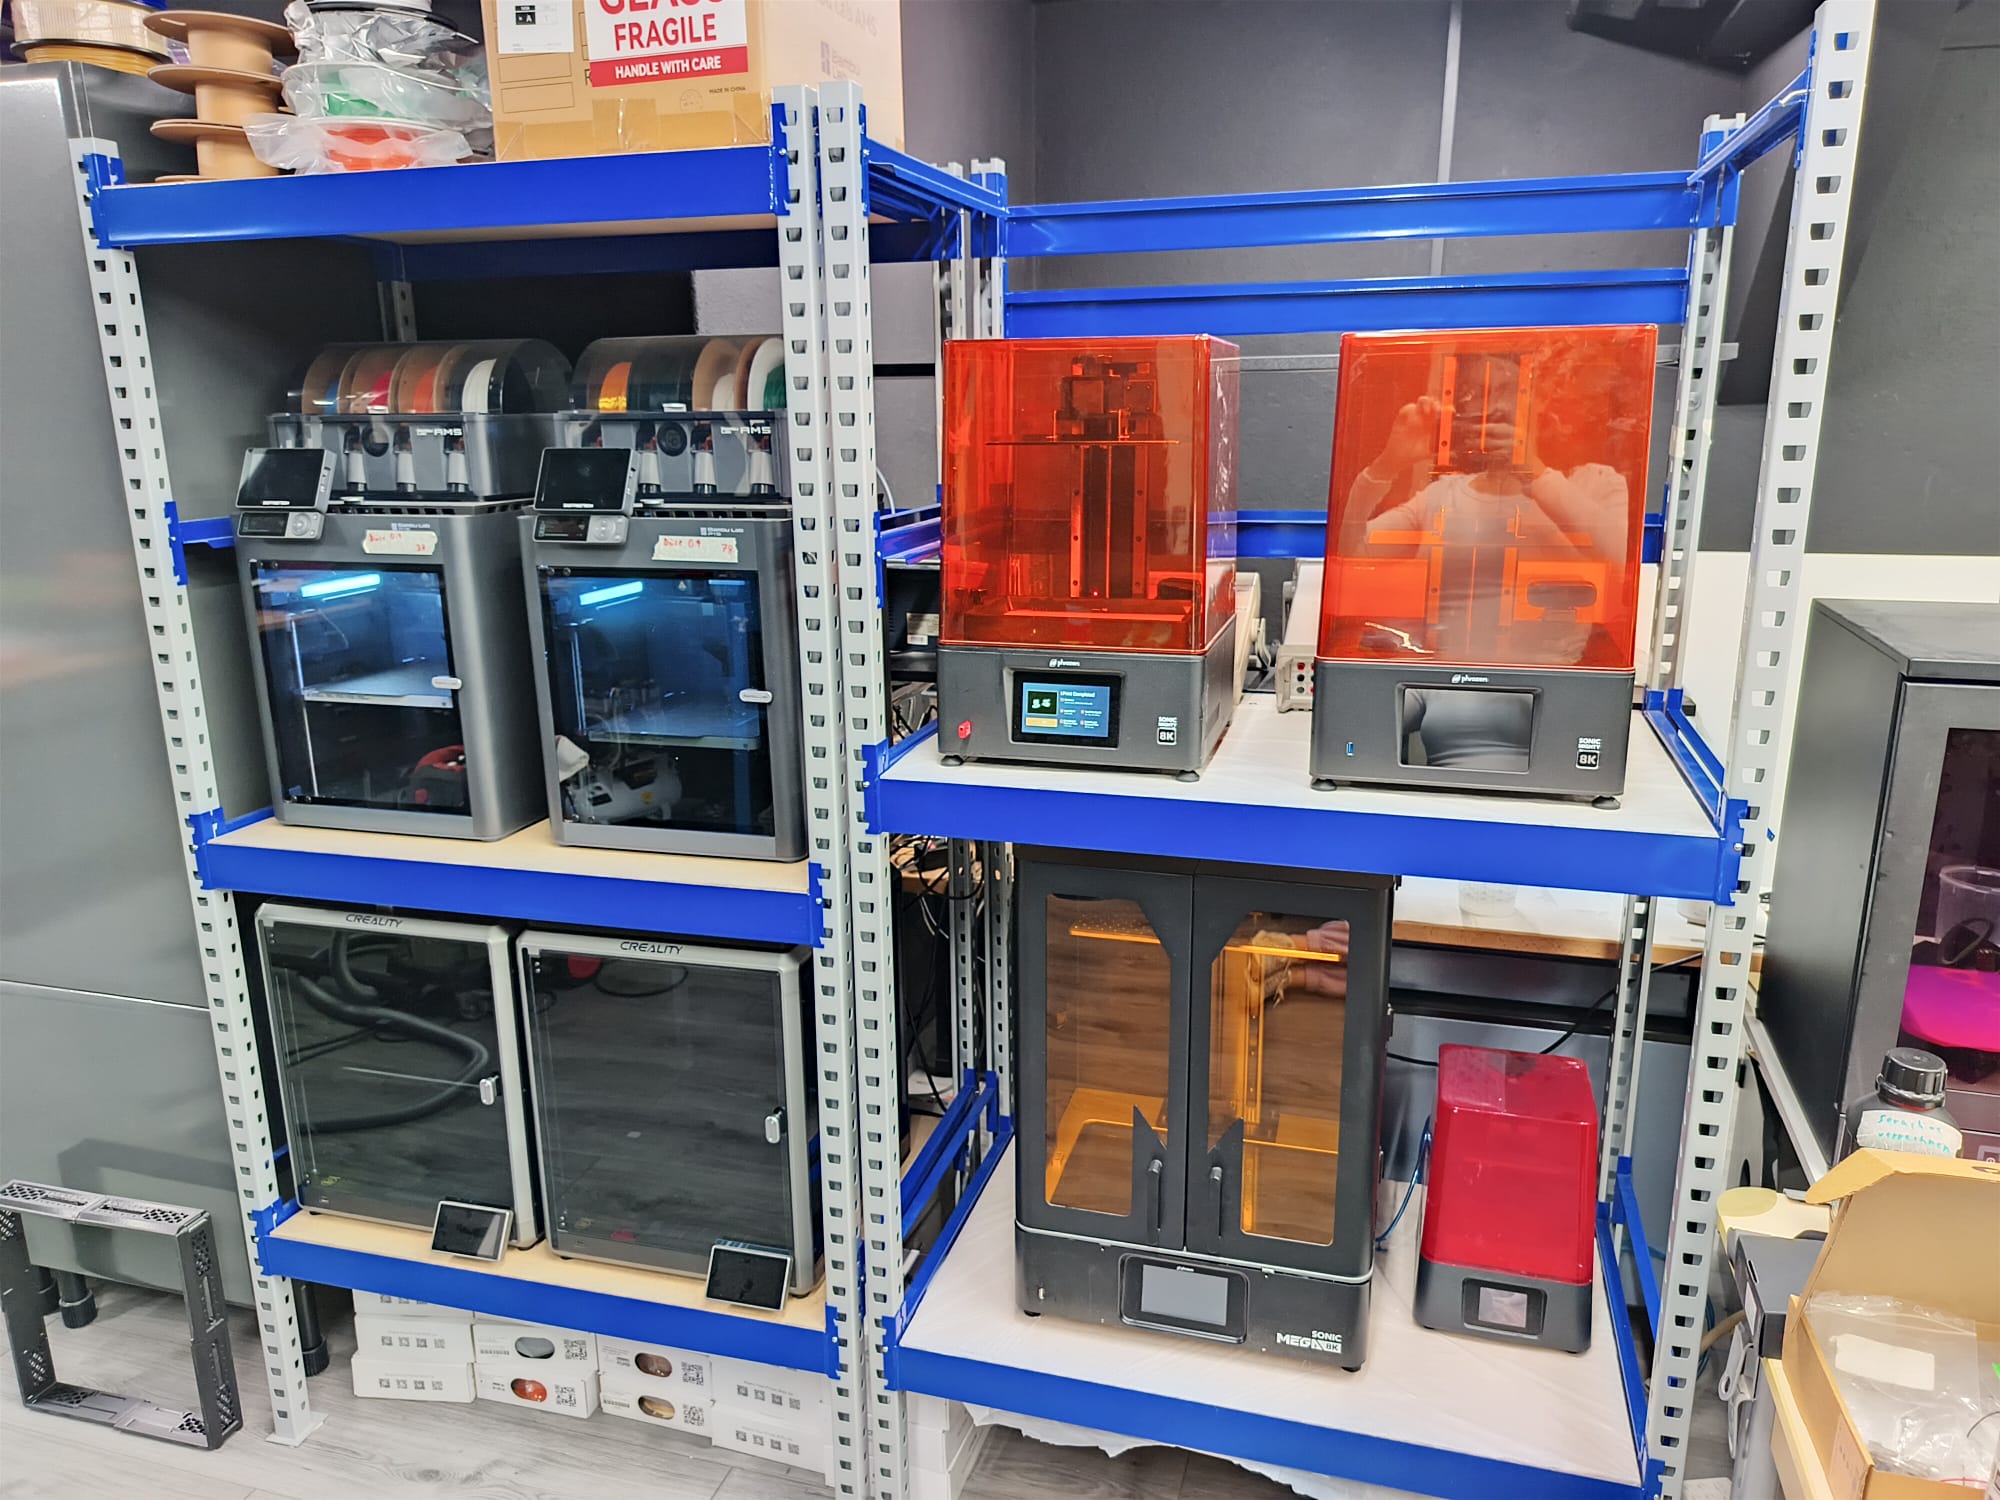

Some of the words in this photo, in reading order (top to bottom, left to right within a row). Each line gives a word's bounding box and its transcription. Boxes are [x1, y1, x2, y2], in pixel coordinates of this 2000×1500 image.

[614, 13, 717, 51] FRAGILE
[615, 62, 660, 79] HANDLE
[661, 58, 690, 74] WITH
[691, 55, 722, 71] CARE
[434, 428, 463, 436] AMS
[740, 426, 771, 434] AMS
[1160, 732, 1174, 741] 8K
[1578, 737, 1601, 745] SONIC
[1580, 755, 1597, 765] 8K
[346, 914, 403, 928] CREALITY
[621, 942, 684, 954] CREALITY
[1277, 1332, 1322, 1350] MEGA
[1311, 1331, 1342, 1342] SONIC
